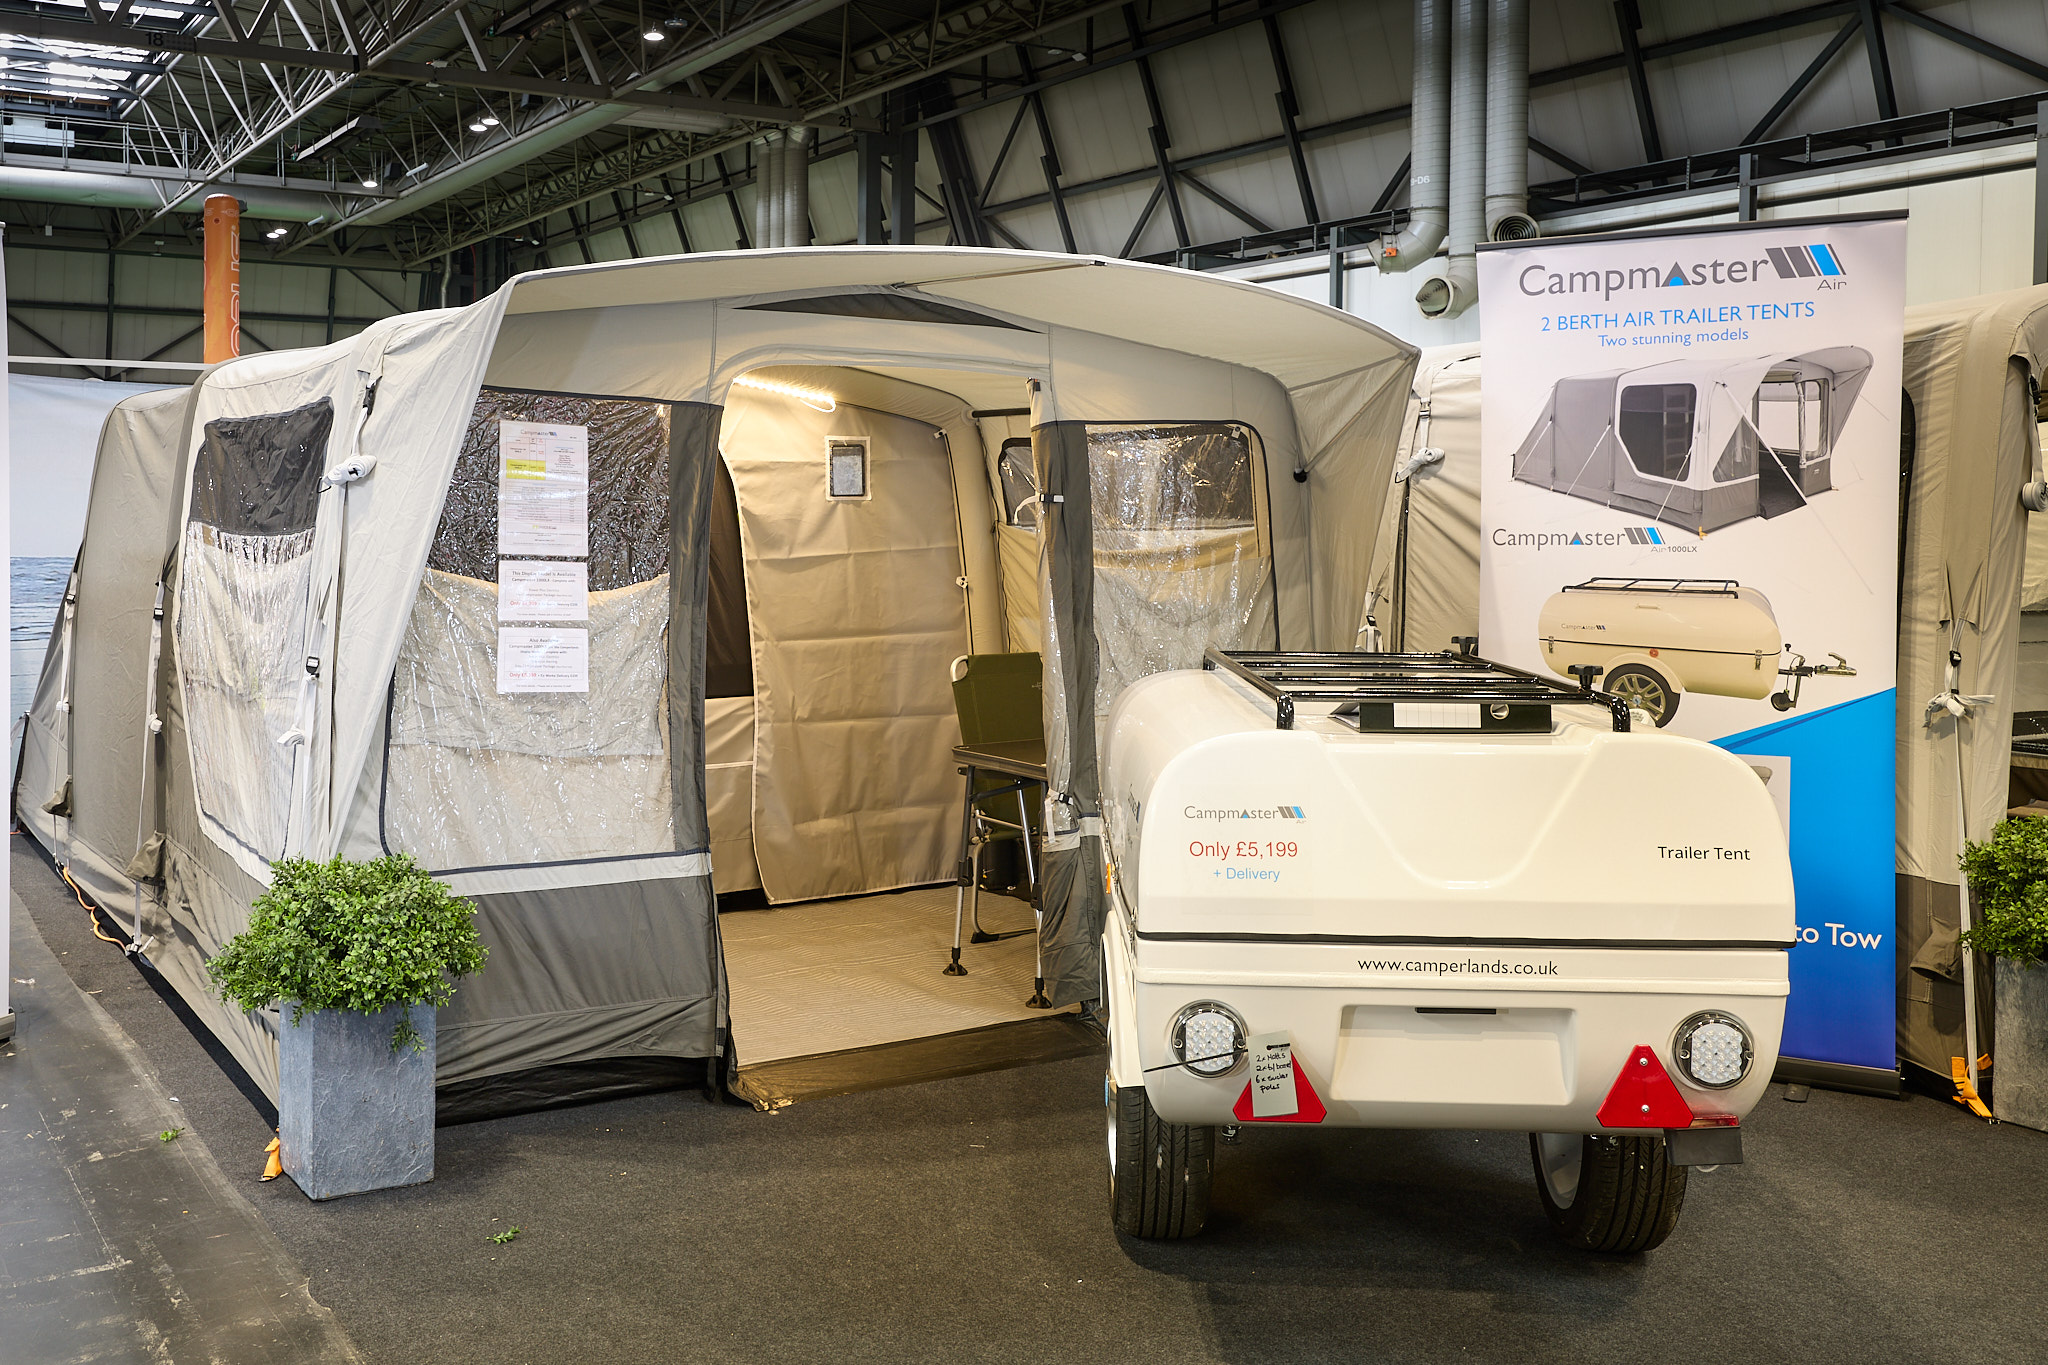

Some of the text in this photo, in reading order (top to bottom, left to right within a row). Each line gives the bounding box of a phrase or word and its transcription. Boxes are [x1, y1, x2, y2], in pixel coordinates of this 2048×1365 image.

[145, 32, 163, 46] 18
[839, 115, 852, 128] 21
[1519, 258, 1769, 301] Campmaster
[1817, 278, 1847, 291] Air
[1541, 301, 1815, 331] 2 BERTH AIR TRAILER TENTS
[1598, 328, 1749, 347] Two stunning models
[1492, 526, 1626, 551] Campmaster
[1184, 805, 1279, 823] Campmaster
[1189, 841, 1298, 861] Only £5,199
[1658, 845, 1751, 862] Trailer Tent
[1226, 867, 1281, 883] Delivery
[1795, 922, 1883, 950] to Tow
[1357, 957, 1559, 977] www.camperlands.co.uk
